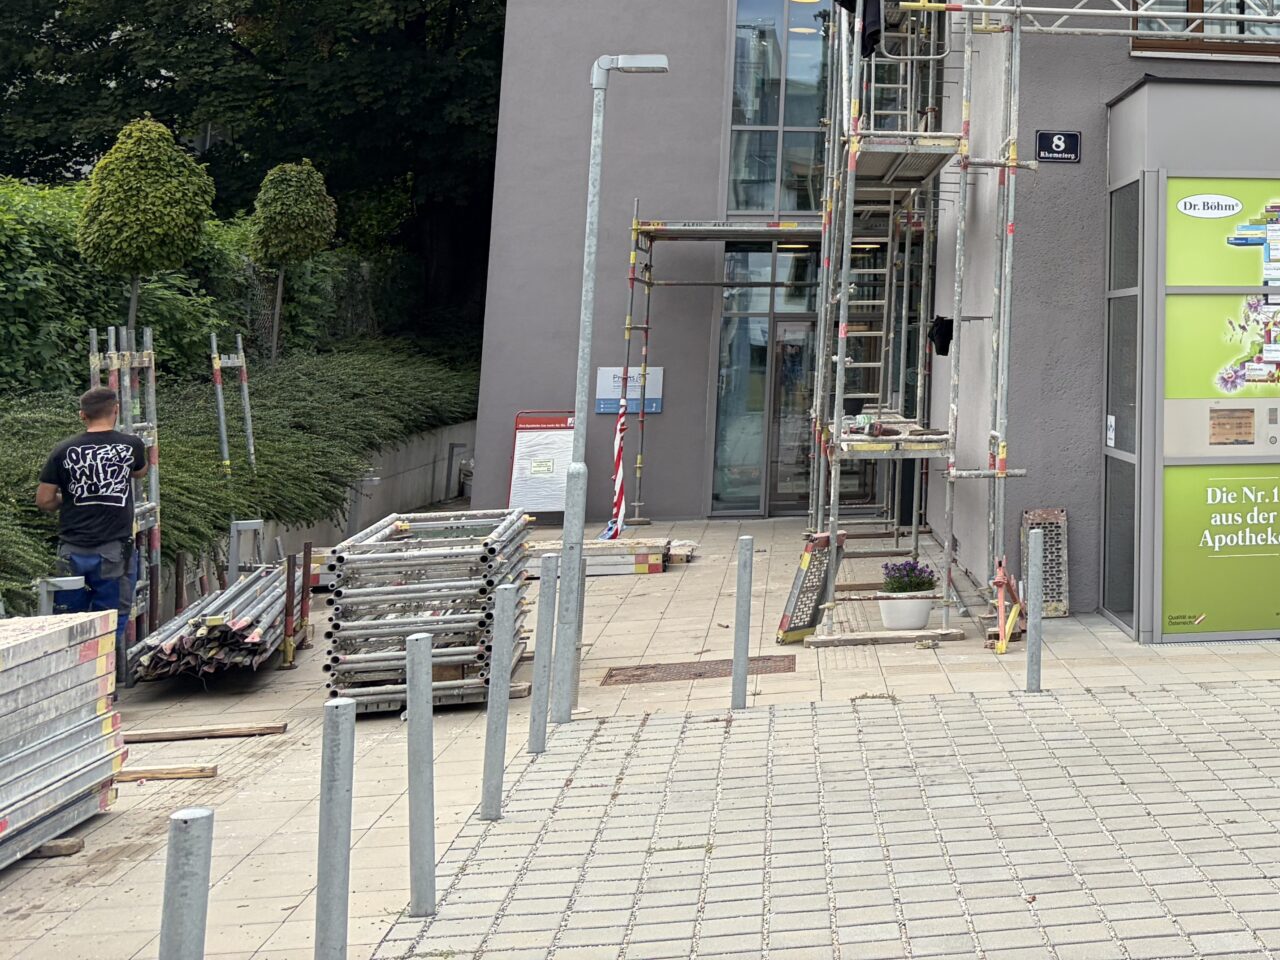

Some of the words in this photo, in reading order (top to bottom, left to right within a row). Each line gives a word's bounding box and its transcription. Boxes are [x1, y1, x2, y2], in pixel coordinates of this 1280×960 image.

[1052, 134, 1066, 152] 8
[1183, 201, 1200, 211] Dr.
[1206, 486, 1237, 504] Die
[1210, 511, 1242, 525] aus
[1246, 505, 1277, 524] der
